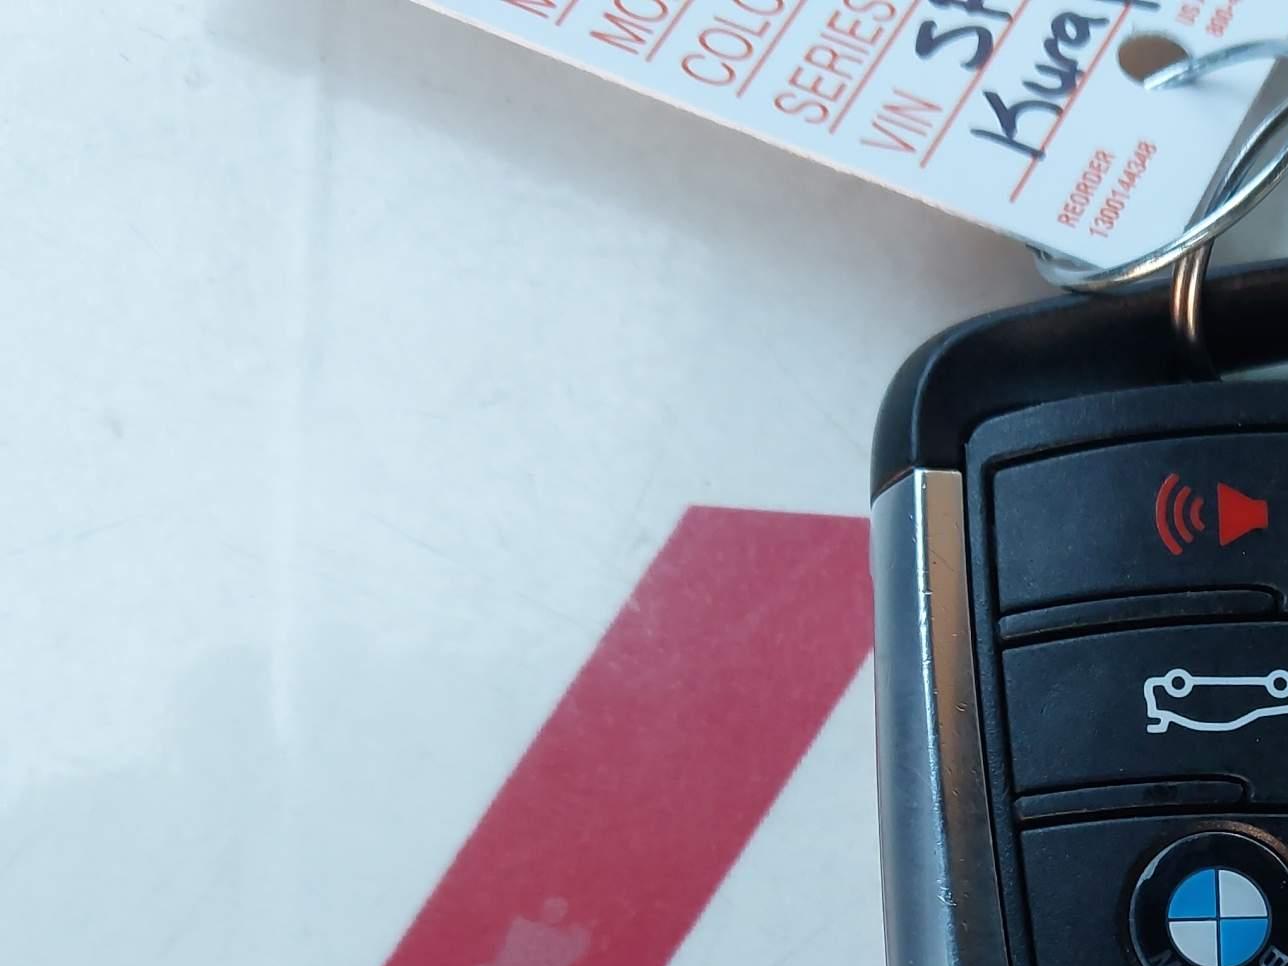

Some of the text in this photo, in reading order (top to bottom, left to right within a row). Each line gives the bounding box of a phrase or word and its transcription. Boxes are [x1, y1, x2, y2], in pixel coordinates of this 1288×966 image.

[773, 0, 897, 125] SERIES
[859, 87, 943, 154] VIN
[1057, 148, 1116, 229] REORDER
[1088, 140, 1157, 238] 1300144348
